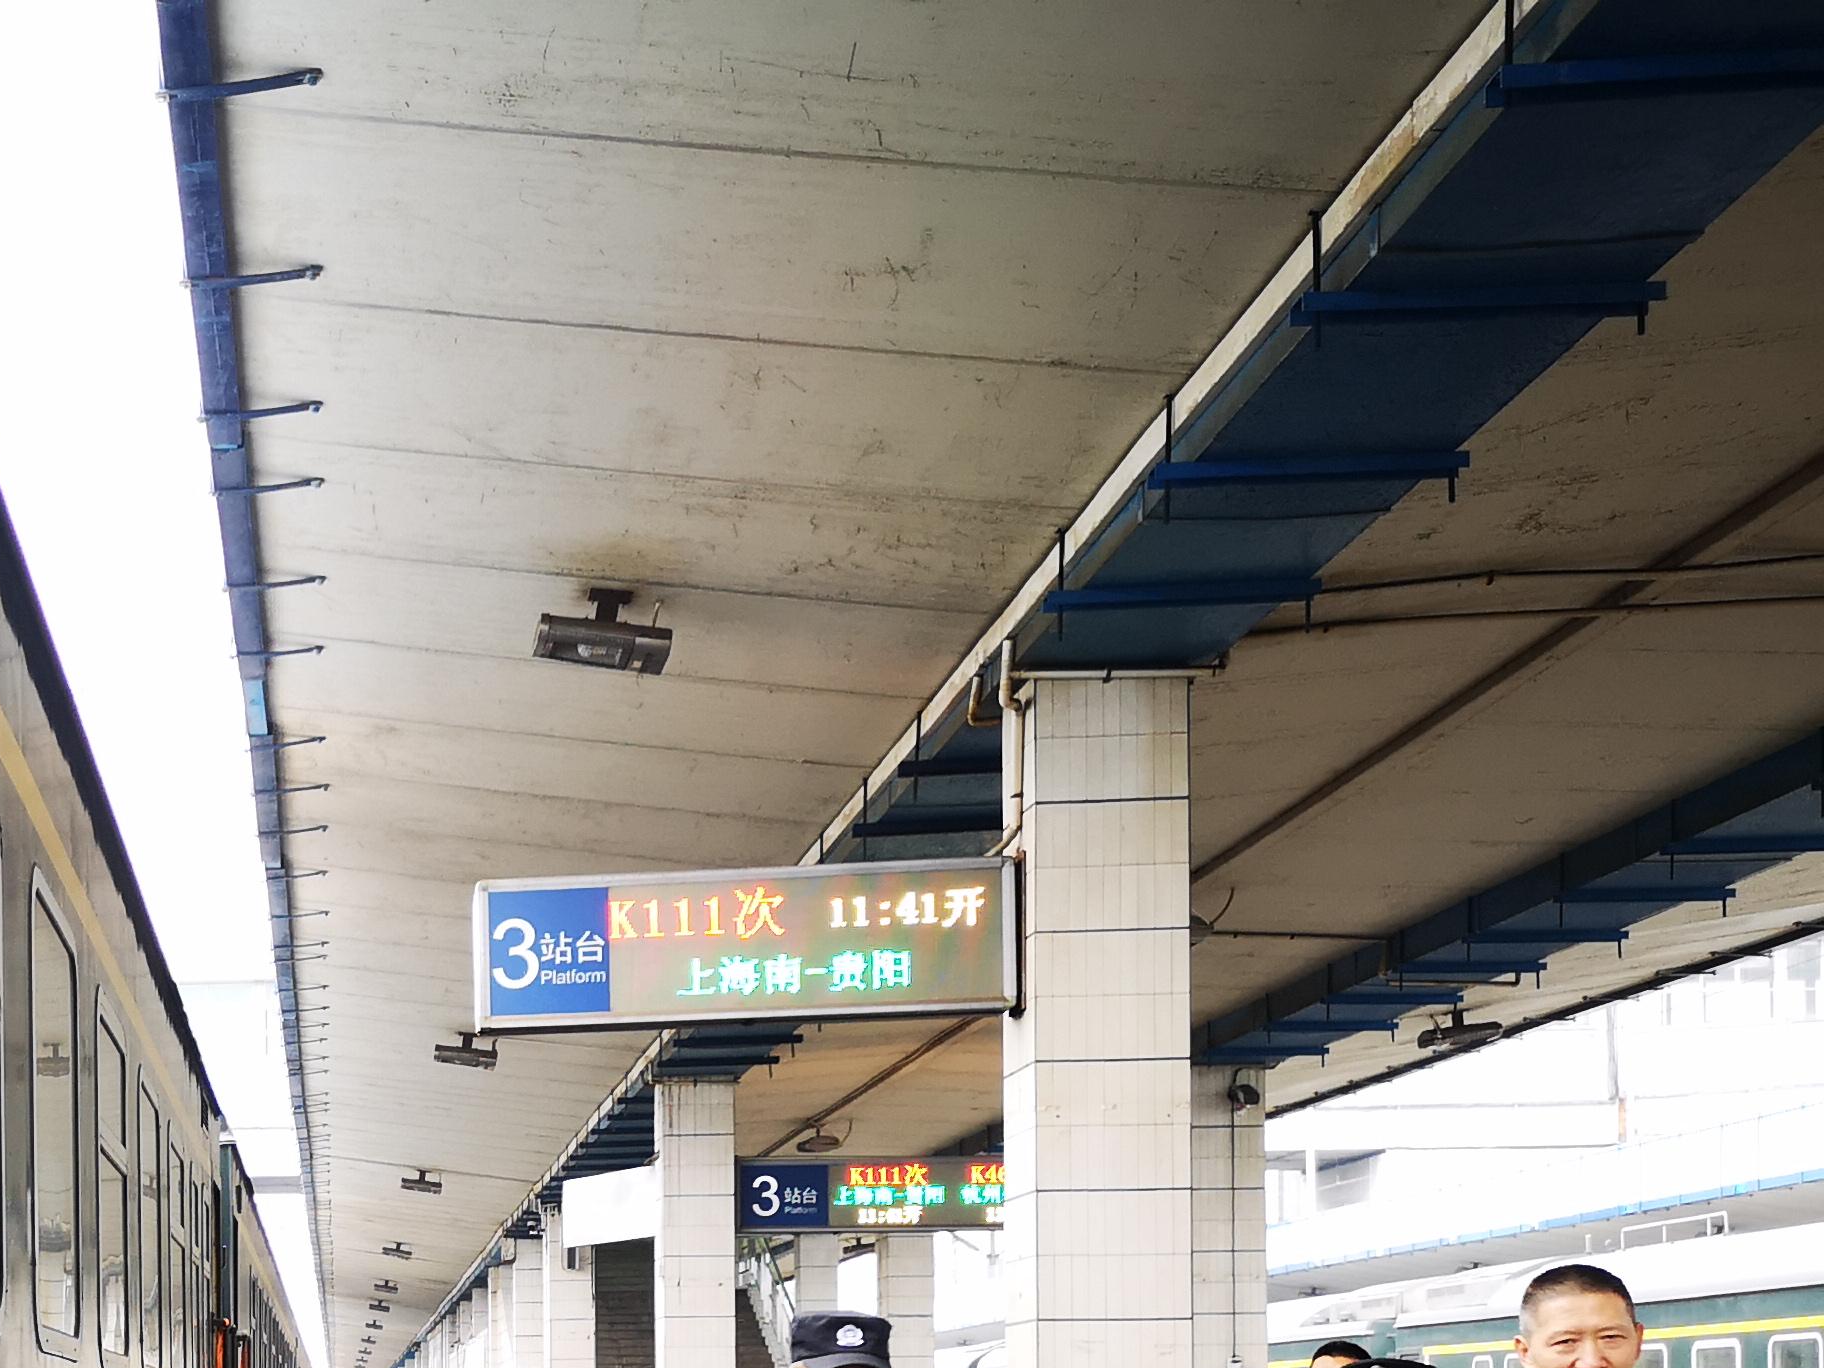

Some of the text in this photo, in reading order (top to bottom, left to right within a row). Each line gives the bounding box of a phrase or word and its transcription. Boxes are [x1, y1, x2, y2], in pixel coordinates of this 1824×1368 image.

[609, 886, 985, 939] K111次 11:41开
[492, 918, 605, 989] 3 站台
[540, 968, 607, 985] Platform
[752, 1175, 818, 1217] 3 站台
